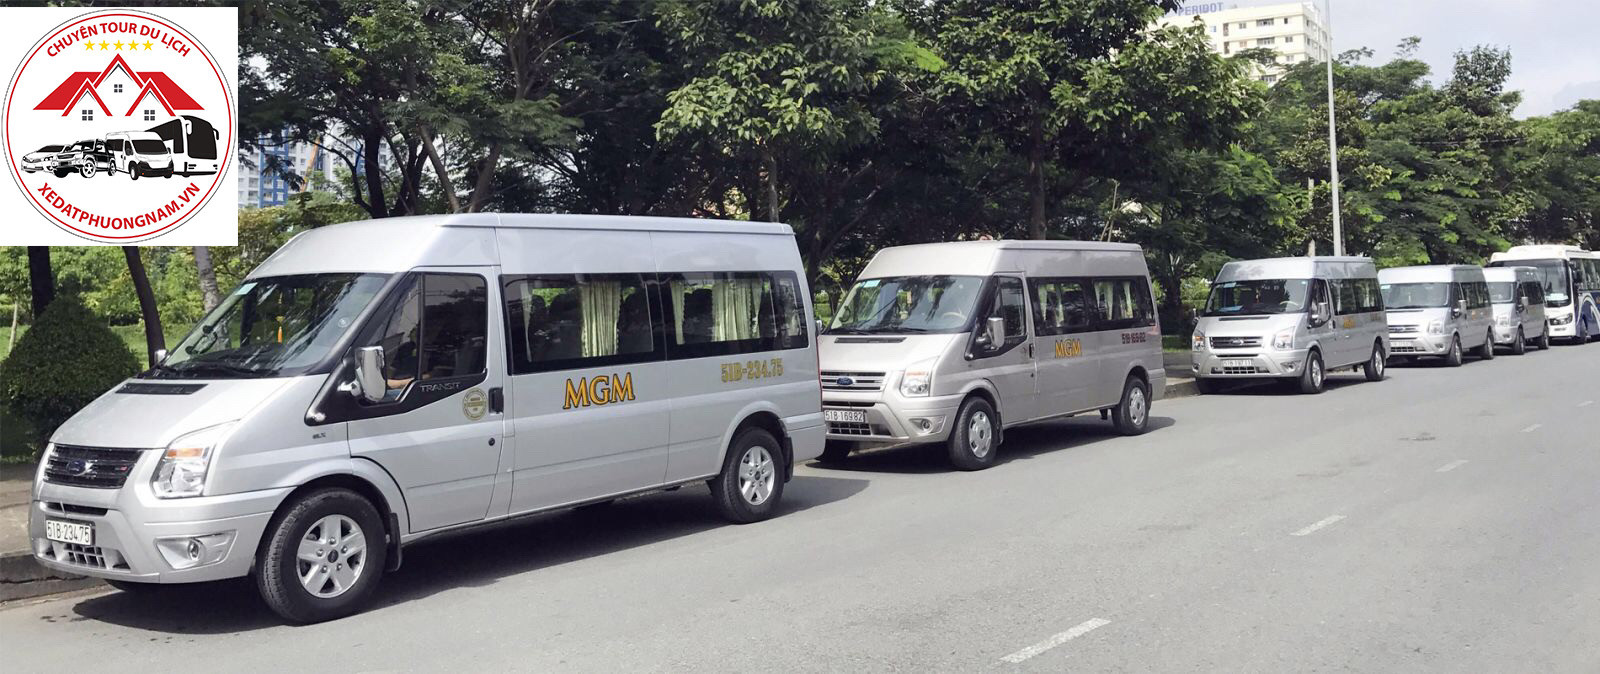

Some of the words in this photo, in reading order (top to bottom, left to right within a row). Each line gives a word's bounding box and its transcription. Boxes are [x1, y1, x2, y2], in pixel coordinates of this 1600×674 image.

[1055, 339, 1082, 359] MGM
[721, 358, 784, 383] 51B-234.75
[419, 382, 461, 393] TRANSIT
[563, 372, 635, 410] MGM
